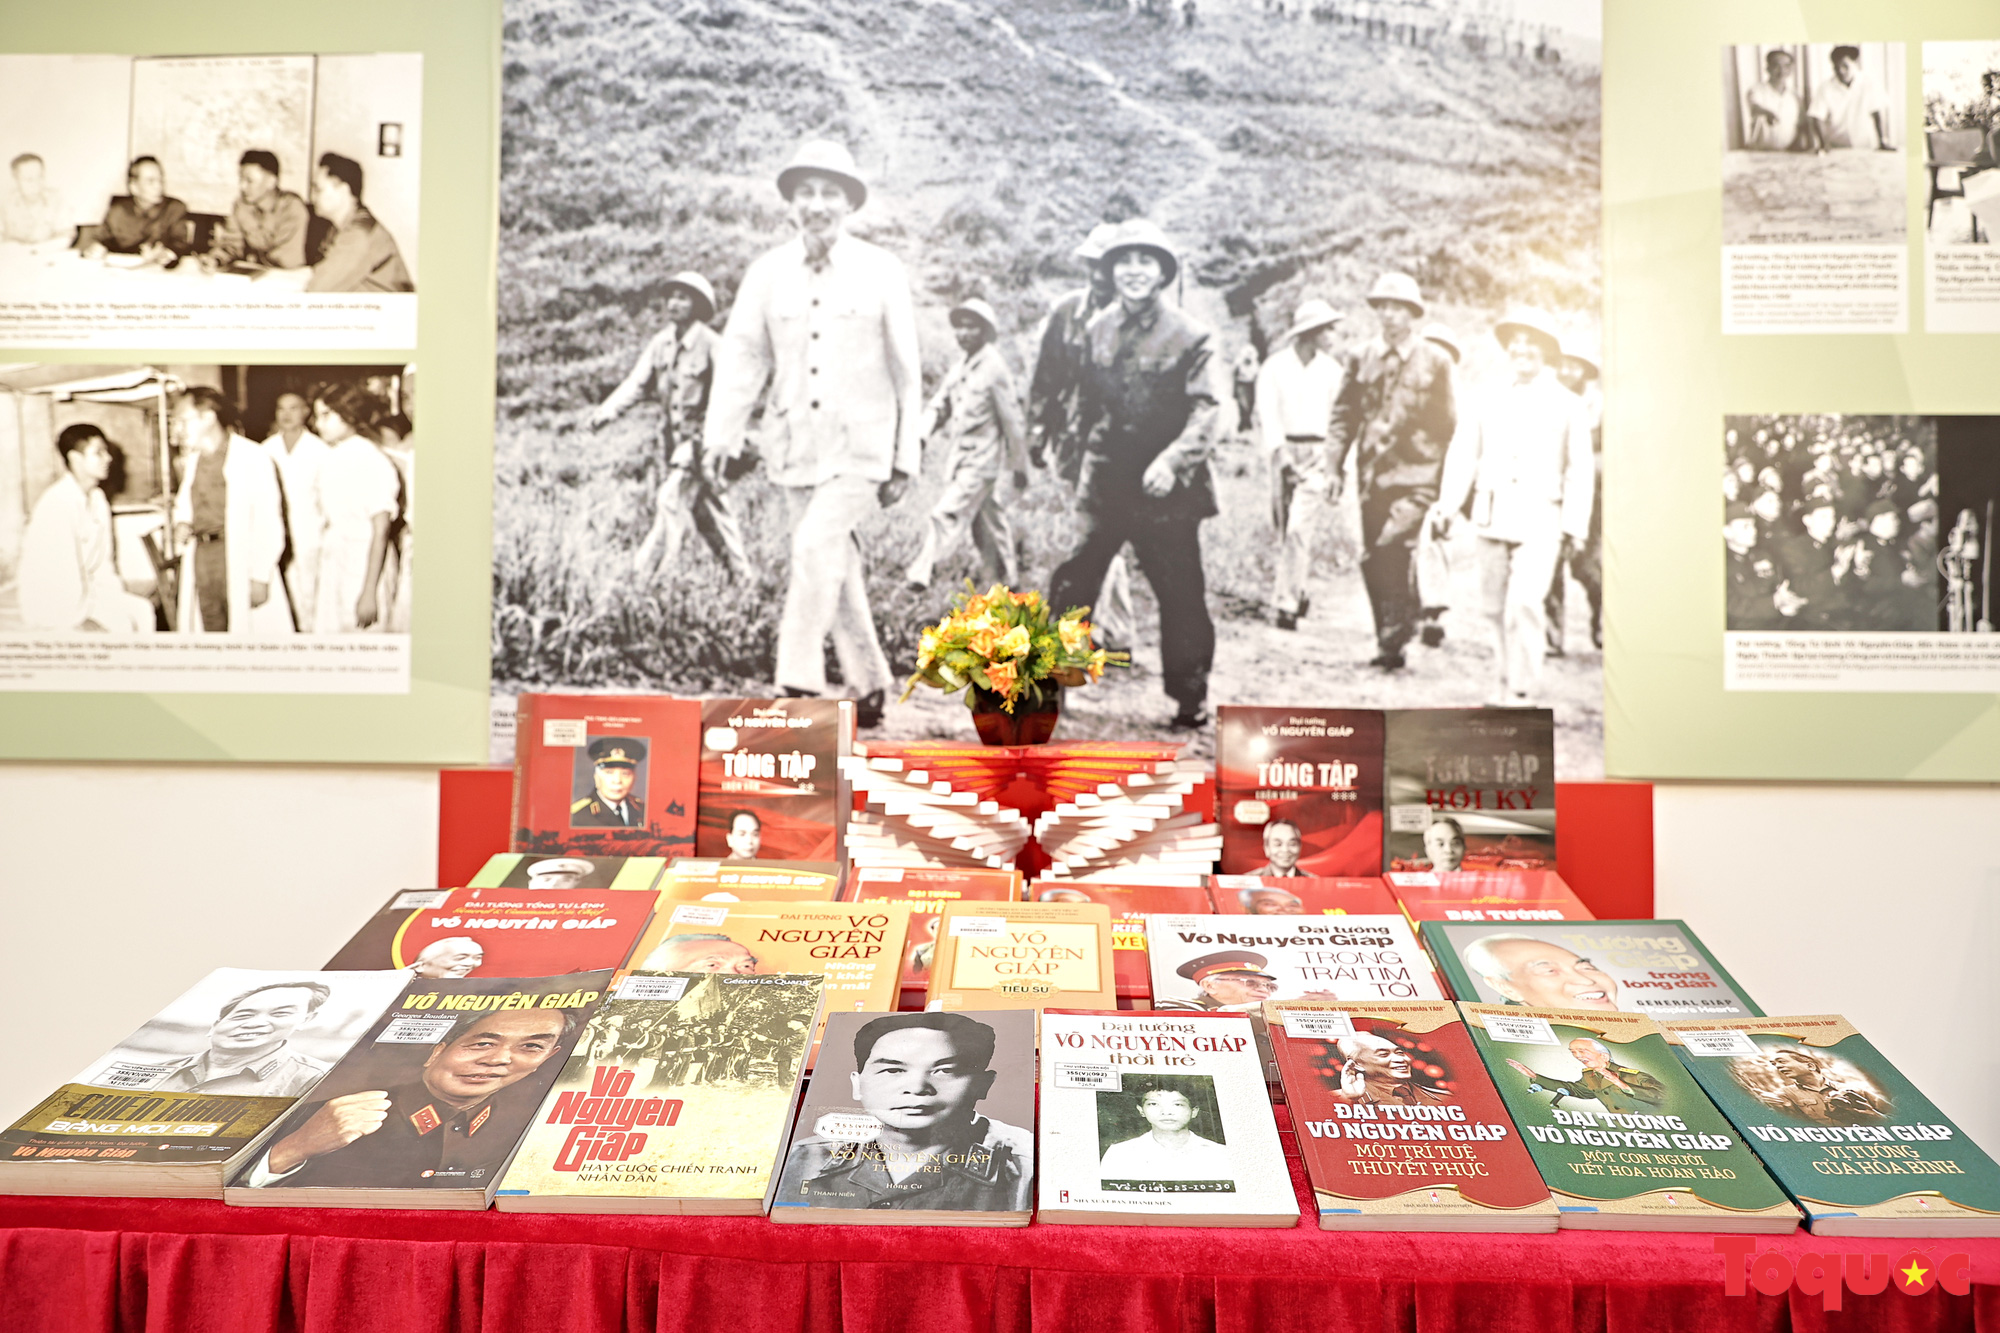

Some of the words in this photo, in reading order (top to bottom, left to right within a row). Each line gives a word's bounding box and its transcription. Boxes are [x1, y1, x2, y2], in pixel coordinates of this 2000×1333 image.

[1262, 724, 1279, 737] VÕ
[1280, 725, 1326, 737] NGUYÊN
[1327, 725, 1354, 737] GIÁP
[722, 748, 775, 778] TỔNG
[778, 750, 816, 783] TẬP
[1492, 750, 1540, 787] TẬP
[1257, 757, 1314, 787] TỔNG
[1318, 759, 1358, 791] TẬP
[1426, 785, 1484, 810] HỒI
[1496, 785, 1540, 810] KÝ
[430, 916, 462, 929] VÕ
[464, 917, 557, 930] NGUYÊN
[561, 917, 617, 930] GIÁP
[848, 913, 889, 928] VÕ
[757, 929, 886, 943] NGUYÊN
[1011, 930, 1046, 944] VÕ
[1298, 925, 1329, 935] Đại
[1333, 925, 1390, 935] tướng
[1177, 932, 1212, 944] Võ
[1217, 933, 1325, 948] Nguyên
[1329, 934, 1394, 948] Giáp
[1562, 934, 1687, 954] Tướng
[810, 944, 882, 959] GIÁP
[970, 945, 1084, 960] NGUYÊN
[1298, 951, 1403, 965] TRONG
[824, 962, 876, 972] Những
[995, 960, 1059, 974] GIÁP
[1294, 964, 1358, 980] TRÁI
[1360, 967, 1411, 981] TIM
[723, 977, 759, 985] Gérard
[774, 978, 810, 986] Quang
[1648, 971, 1711, 980] trong
[1370, 982, 1418, 997] TÔI
[1622, 979, 1674, 990] lòng
[1674, 979, 1717, 988] dân
[402, 990, 442, 1010] VÕ
[442, 992, 538, 1012] NGUYÊN
[539, 988, 600, 1009] GIÁP
[1102, 1022, 1132, 1032] Đại
[1139, 1022, 1196, 1033] tướng
[1055, 1031, 1084, 1048] VÕ
[1091, 1033, 1186, 1051] NGUYÊN
[1192, 1034, 1247, 1052] GIÁP
[1109, 1053, 1154, 1065] thời
[1164, 1053, 1196, 1066] trẻ
[590, 1066, 635, 1097] Võ
[545, 1091, 684, 1131] Nguyên
[1334, 1103, 1379, 1122] ĐẠI
[1380, 1102, 1467, 1122] TƯỚNG
[45, 1120, 118, 1133] BẰNG
[122, 1124, 172, 1134] MỌI
[174, 1122, 219, 1134] GIÁ
[1551, 1109, 1600, 1128] ĐẠI
[1599, 1111, 1688, 1131] TƯỚNG
[1305, 1119, 1341, 1138] VÕ
[1342, 1121, 1447, 1141] NGUYÊN
[1448, 1121, 1508, 1141] GIÁP
[1747, 1123, 1790, 1142] VÕ
[1786, 1124, 1895, 1142] NGUYÊN
[1890, 1122, 1954, 1141] GIÁP
[1527, 1125, 1566, 1144] VÕ
[1564, 1129, 1673, 1149] NGUYÊN
[1671, 1132, 1733, 1151] GIÁP
[12, 1146, 35, 1157] Võ
[36, 1146, 98, 1159] Nguyên
[98, 1146, 138, 1159] Giáp
[553, 1126, 648, 1172] Giáp
[1354, 1142, 1396, 1160] MỘT
[1399, 1143, 1436, 1159] TRÍ
[1436, 1144, 1477, 1161] TUỆ
[1821, 1145, 1850, 1159] VỊ
[1847, 1142, 1920, 1159] TƯỚNG
[829, 1150, 856, 1161] VÕ
[860, 1151, 940, 1164] NGUYÊN
[945, 1152, 991, 1164] GIÁP
[1581, 1150, 1616, 1165] MỘT
[1619, 1153, 1652, 1164] CON
[1652, 1153, 1708, 1166] NGƯỜI
[581, 1164, 613, 1172] HAY
[616, 1163, 657, 1174] CUỘC
[661, 1163, 704, 1174] CHIẾN
[709, 1165, 757, 1174] TRANH
[918, 1161, 942, 1173] TRẺ
[1348, 1158, 1429, 1176] THUYẾT
[1430, 1162, 1489, 1178] PHỤC
[1568, 1161, 1606, 1176] VIẾT
[1607, 1165, 1647, 1178] HOA
[1647, 1166, 1698, 1179] HOÀN
[1697, 1165, 1736, 1179] HẢO
[1812, 1158, 1858, 1175] CỦA
[1857, 1158, 1909, 1175] HÒA
[1905, 1157, 1965, 1174] BÌNH
[576, 1172, 621, 1182] NHÂN
[624, 1172, 658, 1183] DÂN
